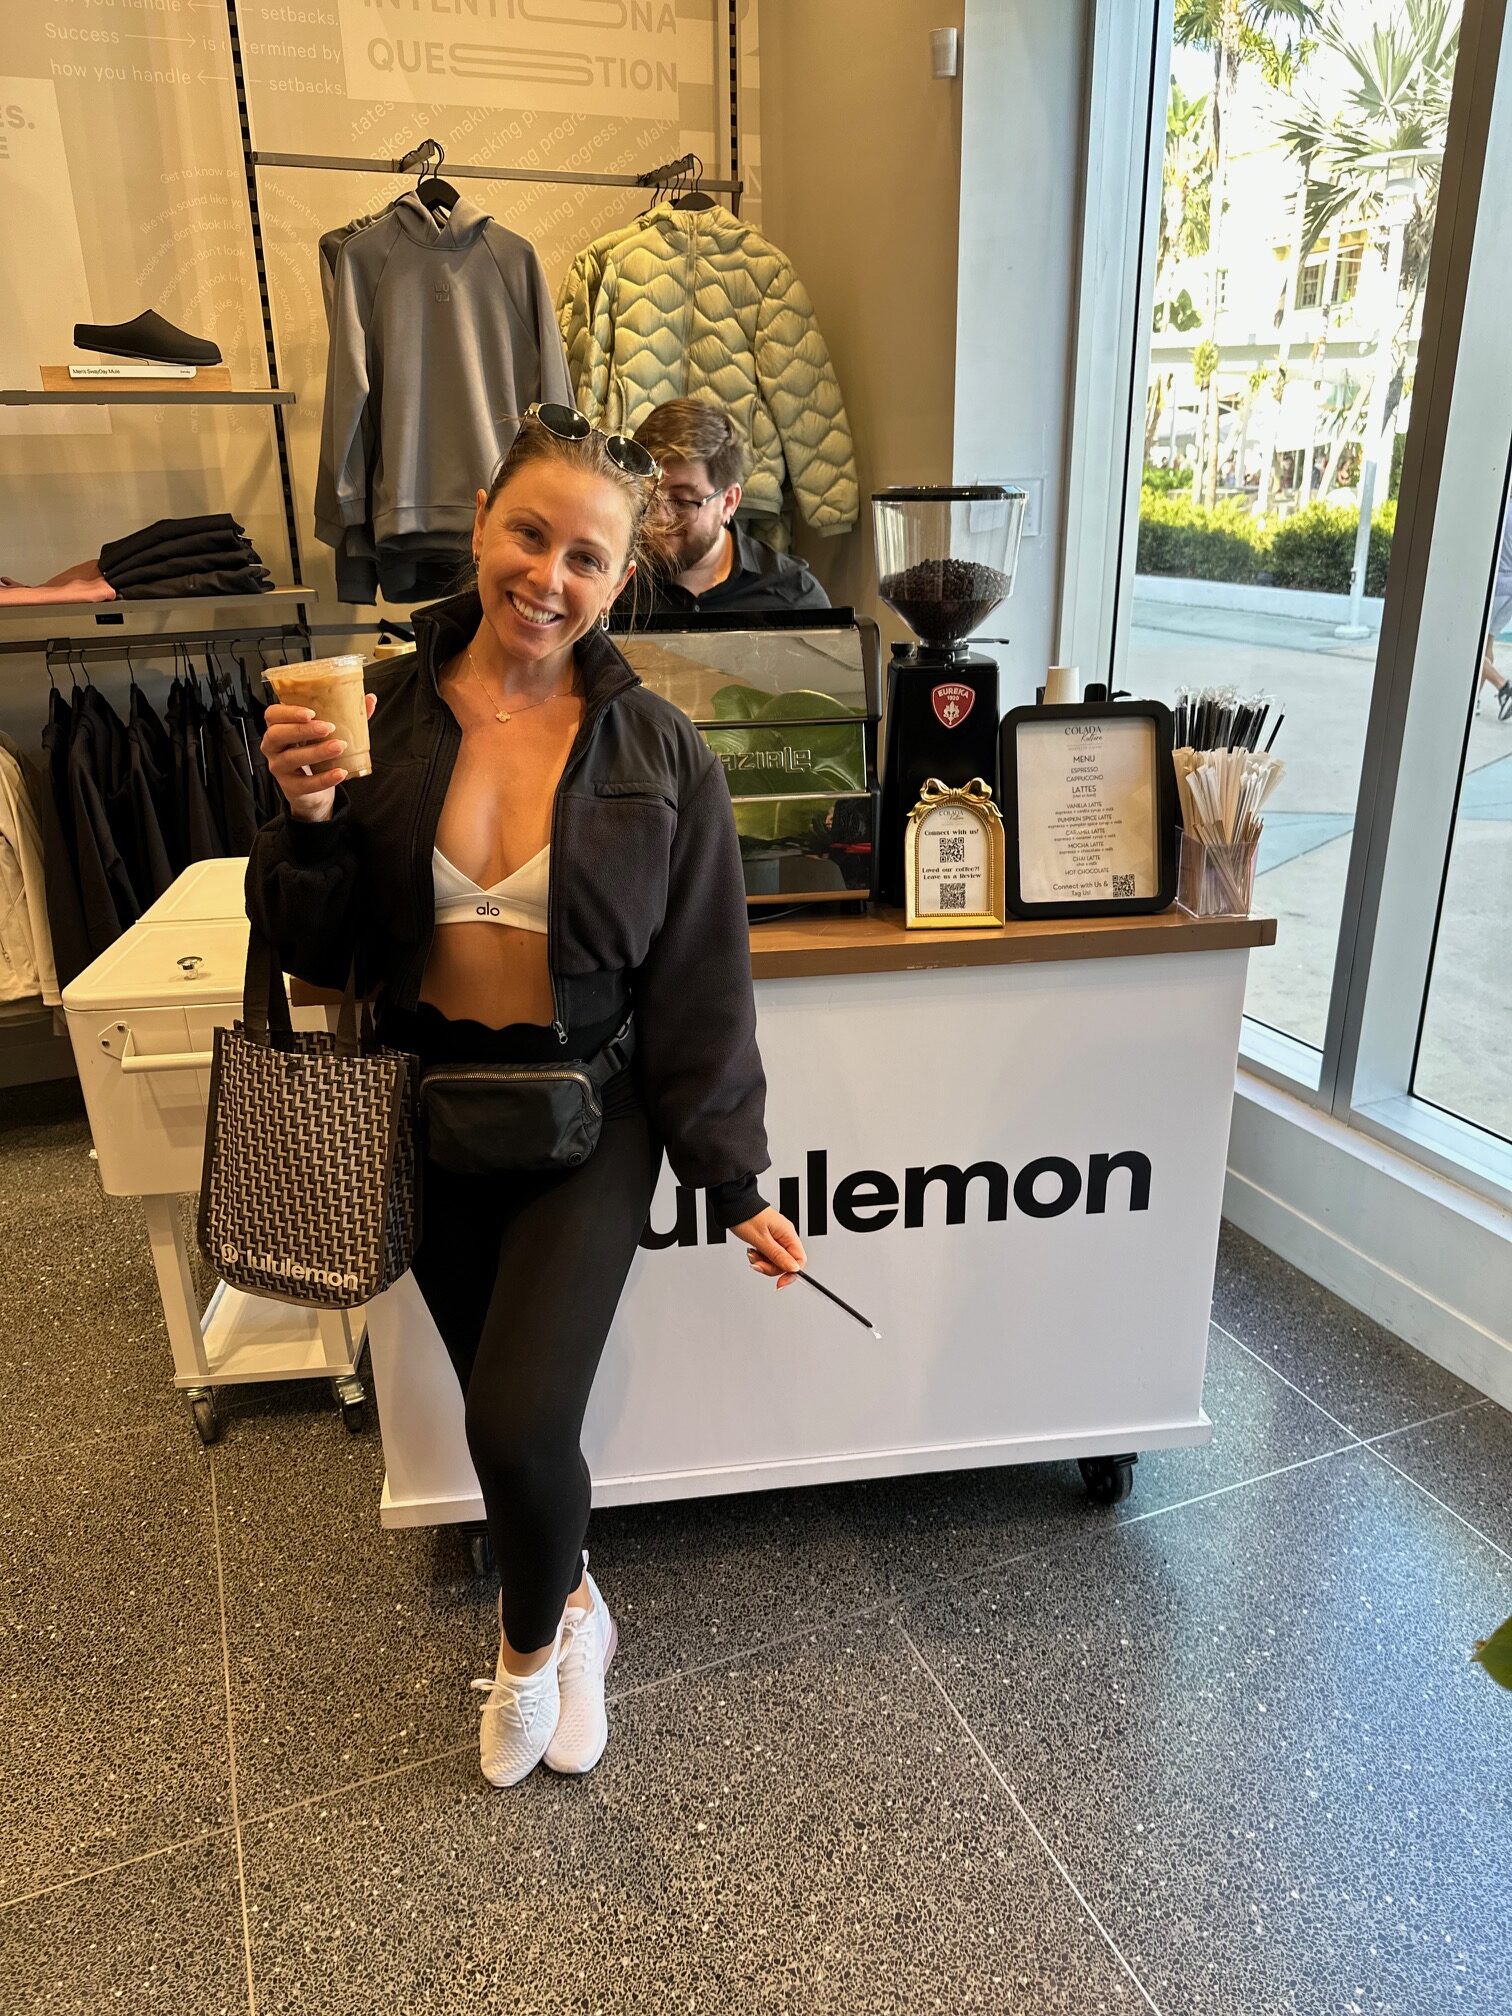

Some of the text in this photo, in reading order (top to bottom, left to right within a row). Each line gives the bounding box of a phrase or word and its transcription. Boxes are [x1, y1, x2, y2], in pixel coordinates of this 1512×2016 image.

[261, 6, 339, 26] setbacks.
[45, 22, 343, 63] Success is termined by
[367, 38, 677, 93] QUESTION
[50, 58, 346, 95] how you handle setbacks.
[449, 104, 503, 144] makin
[160, 172, 180, 185] Get
[181, 169, 193, 179] to
[194, 166, 223, 178] know
[176, 194, 207, 212] sound
[209, 193, 228, 206] like
[135, 255, 160, 288] people
[156, 239, 175, 258] who
[198, 219, 221, 233] look
[222, 219, 242, 232] like
[937, 687, 969, 699] EUREKA
[1064, 725, 1102, 736] COLADA
[1072, 755, 1095, 764] MENU
[1066, 774, 1104, 783] CAPPUCCINO
[1070, 766, 1098, 774] ESPRESSO
[1072, 784, 1097, 794] LATTES
[1077, 867, 1109, 875] CHOCOLATE
[1052, 883, 1079, 891] Connect
[476, 901, 500, 916] alo
[638, 1149, 1152, 1250] ulemon
[247, 1249, 359, 1291] lululemon
